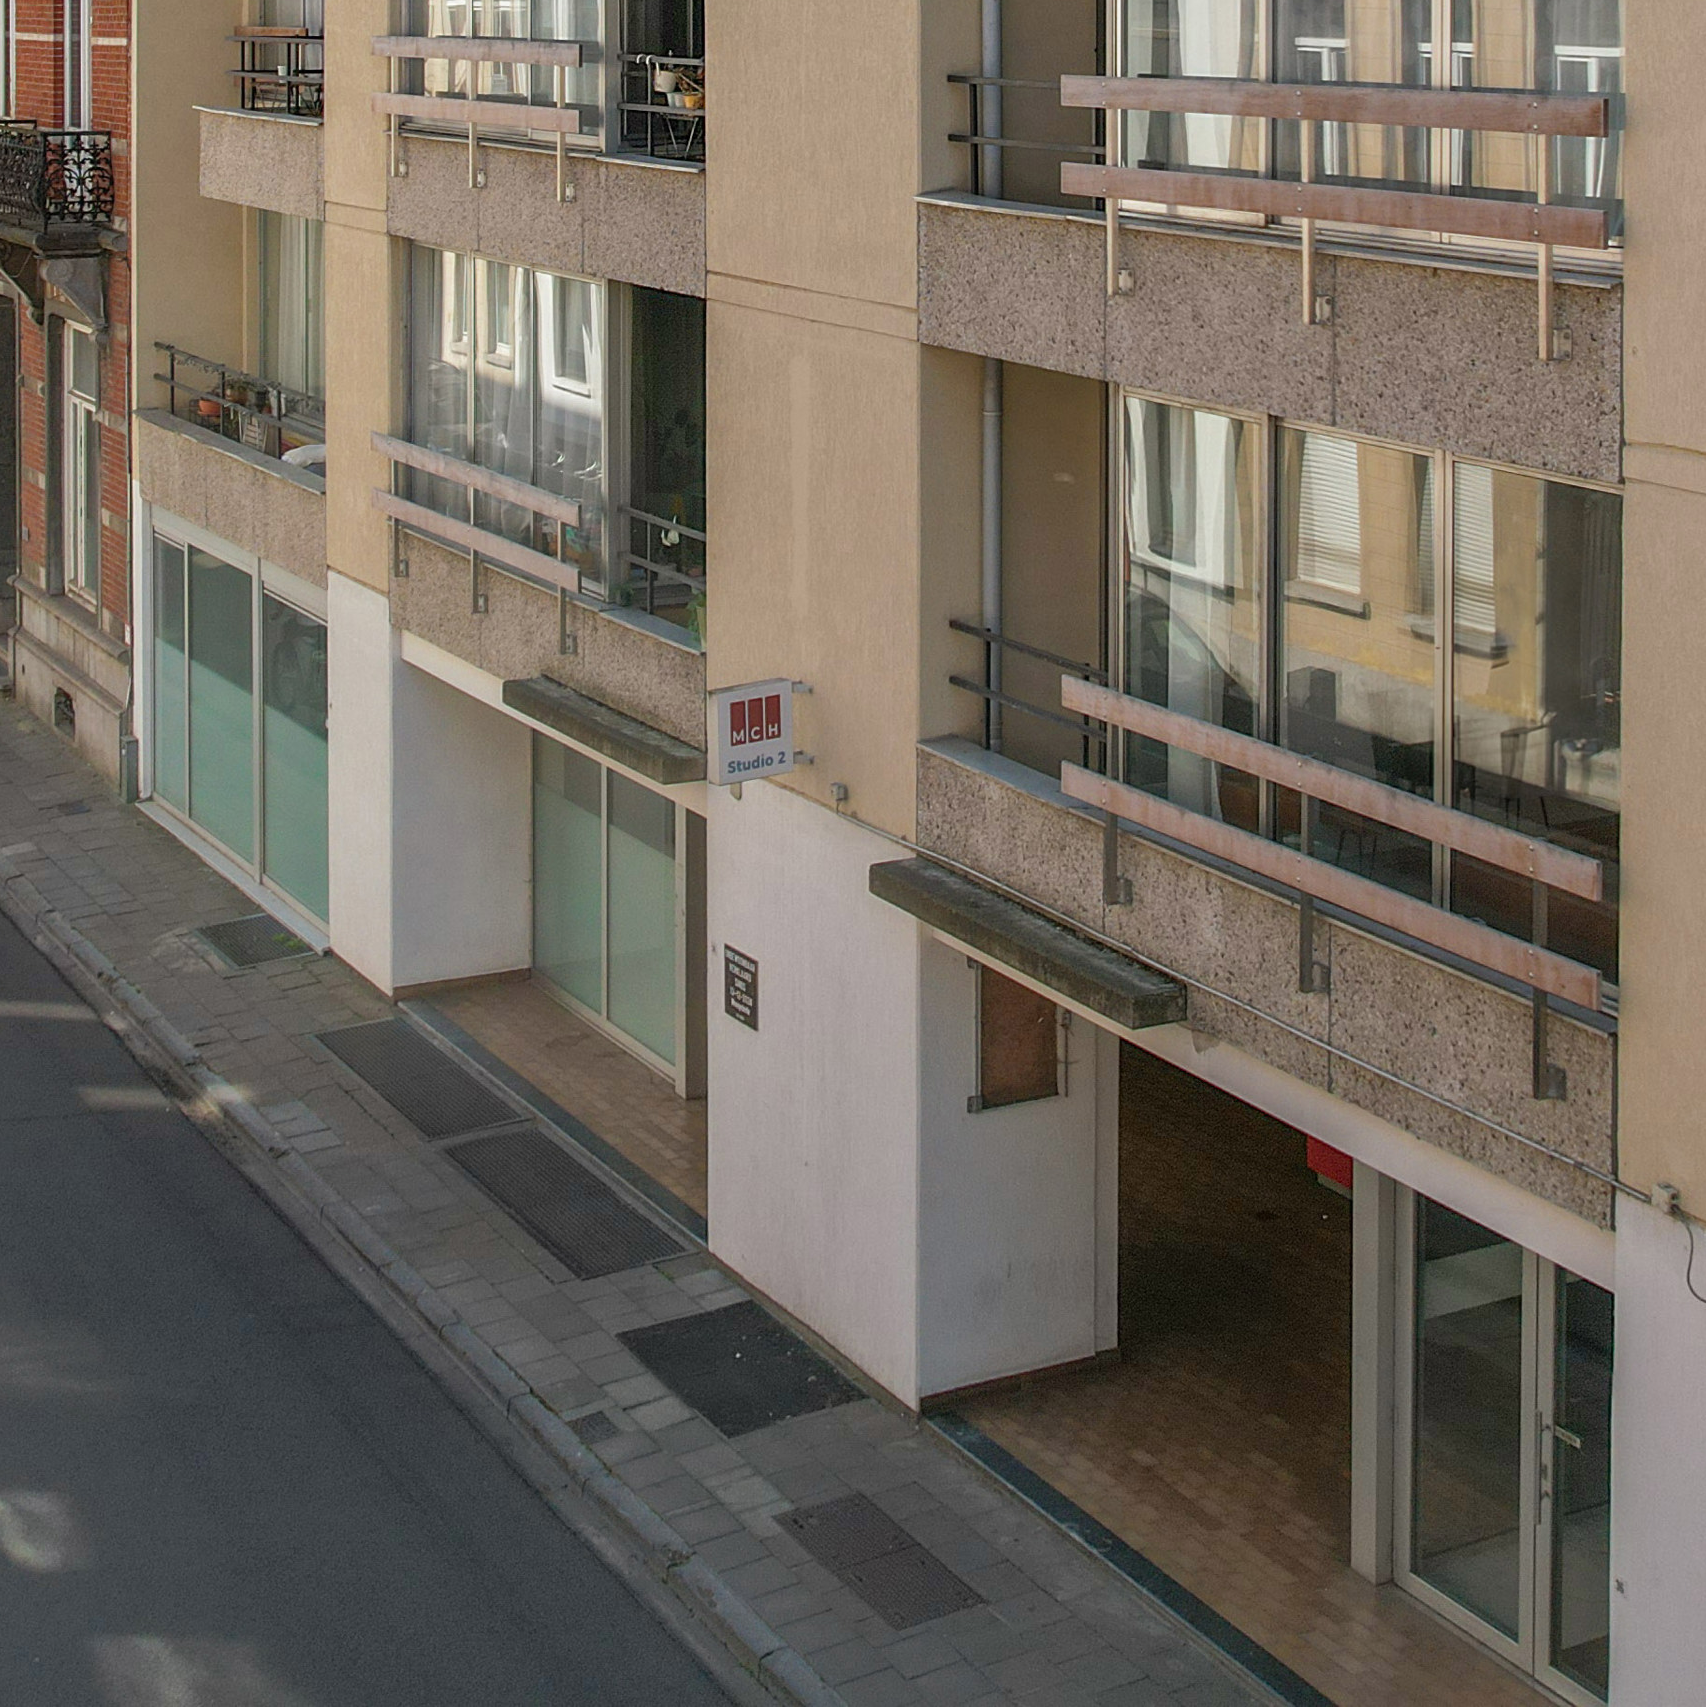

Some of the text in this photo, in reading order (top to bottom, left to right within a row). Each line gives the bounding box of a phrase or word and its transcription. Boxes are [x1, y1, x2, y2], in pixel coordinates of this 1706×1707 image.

[732, 723, 779, 744] MCH
[727, 751, 786, 774] Studio 2
